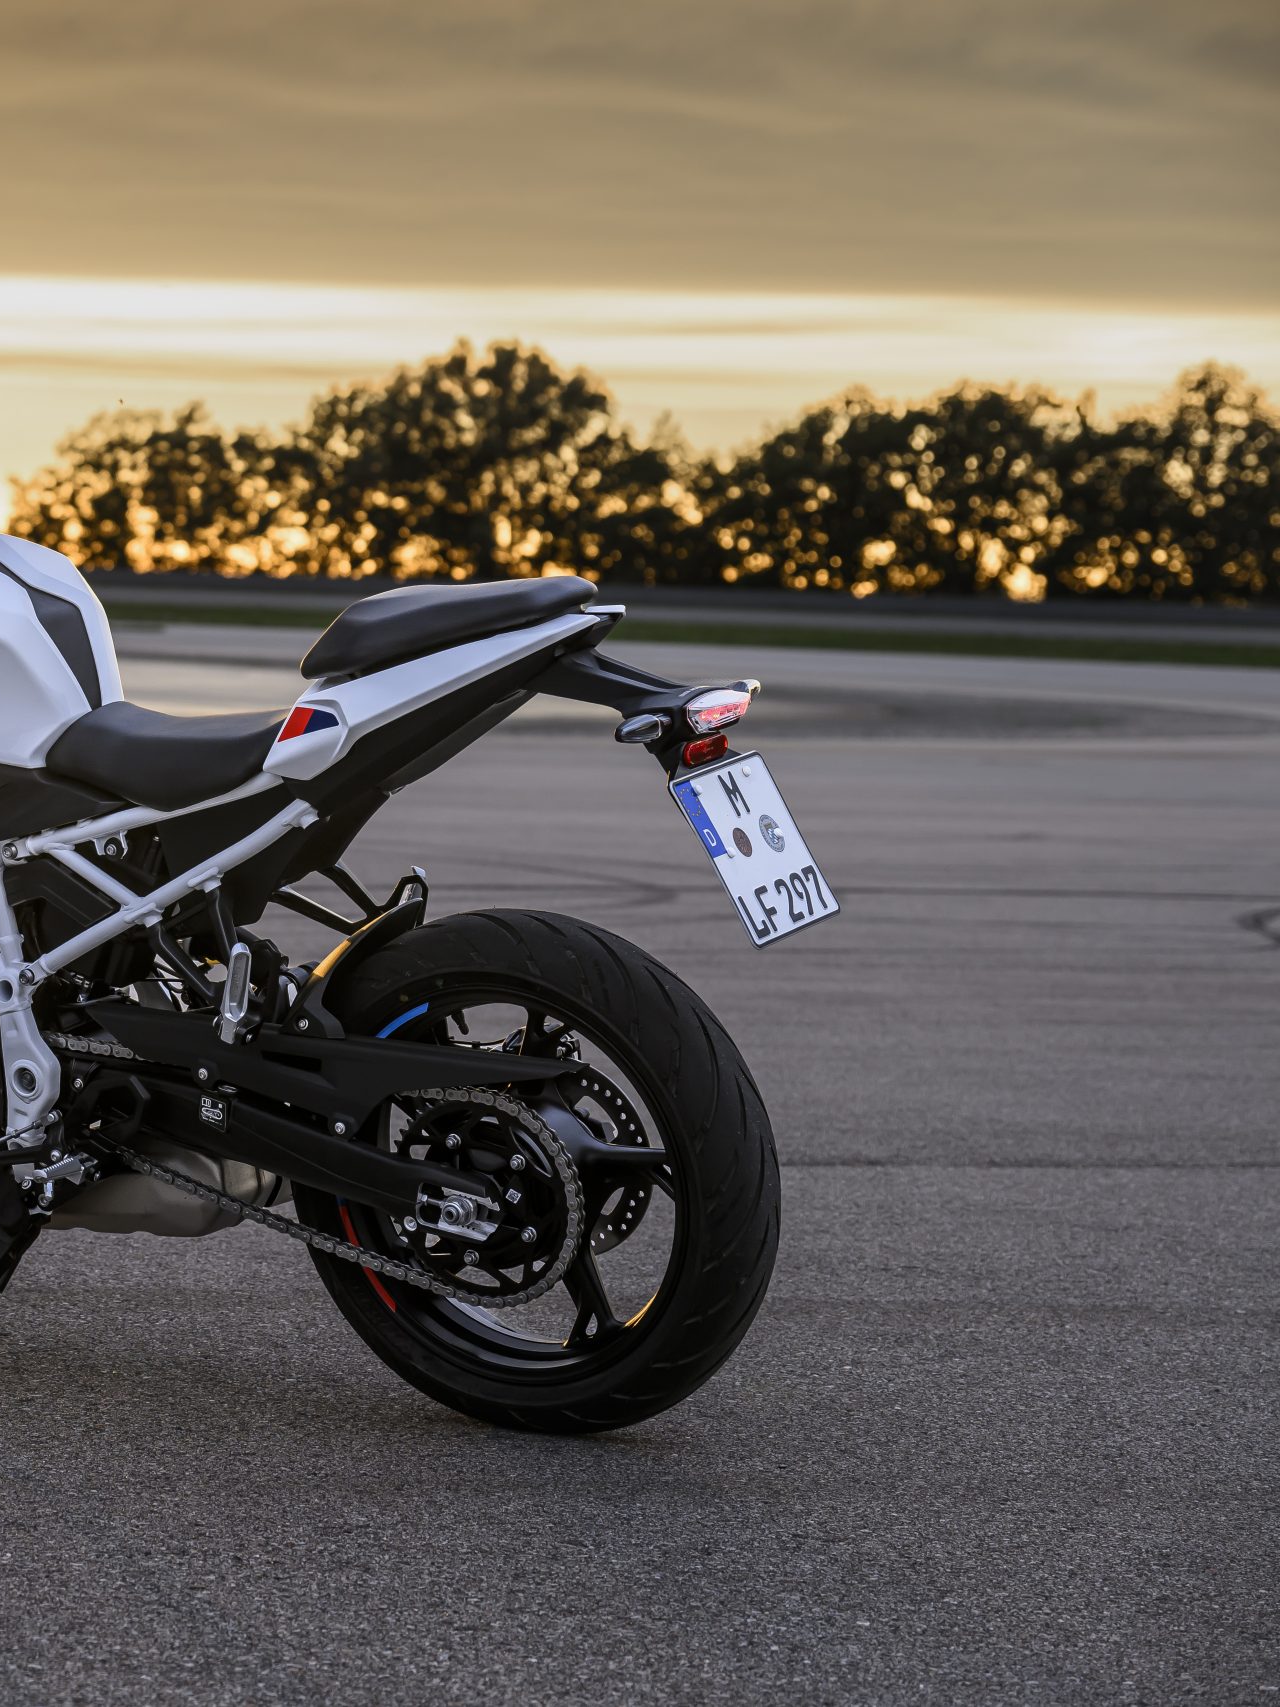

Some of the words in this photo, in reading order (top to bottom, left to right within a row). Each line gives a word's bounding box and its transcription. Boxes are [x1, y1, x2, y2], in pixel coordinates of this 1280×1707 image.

[717, 770, 751, 817] M
[702, 828, 717, 847] D
[737, 884, 778, 939] LF
[773, 864, 828, 923] 297
